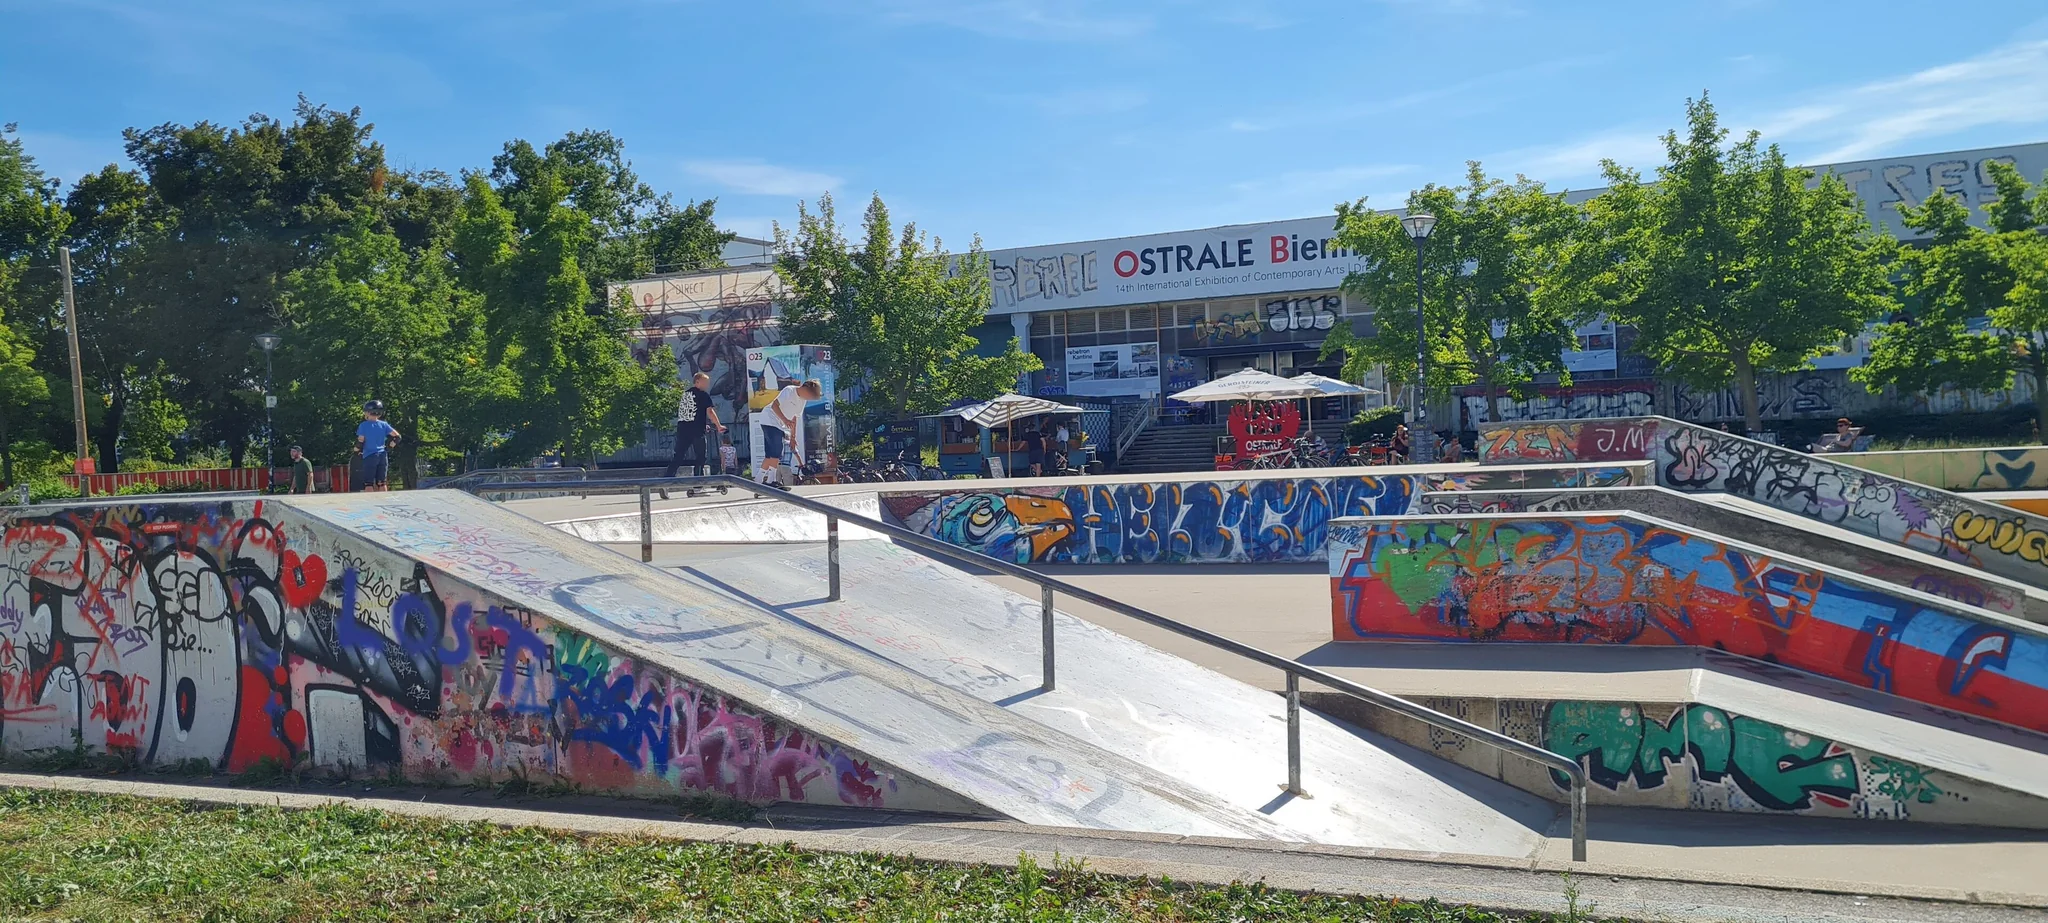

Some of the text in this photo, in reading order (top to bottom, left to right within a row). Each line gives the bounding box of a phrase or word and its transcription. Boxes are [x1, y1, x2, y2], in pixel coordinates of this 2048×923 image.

[1113, 239, 1254, 278] OSTRALE
[675, 281, 705, 295] DIRECT
[1115, 284, 1135, 293] 14th
[1137, 277, 1192, 292] International
[1195, 274, 1239, 287] Exhibition
[1241, 272, 1252, 282] of
[1253, 267, 1322, 281] Contemporary
[1324, 265, 1345, 276] Arts
